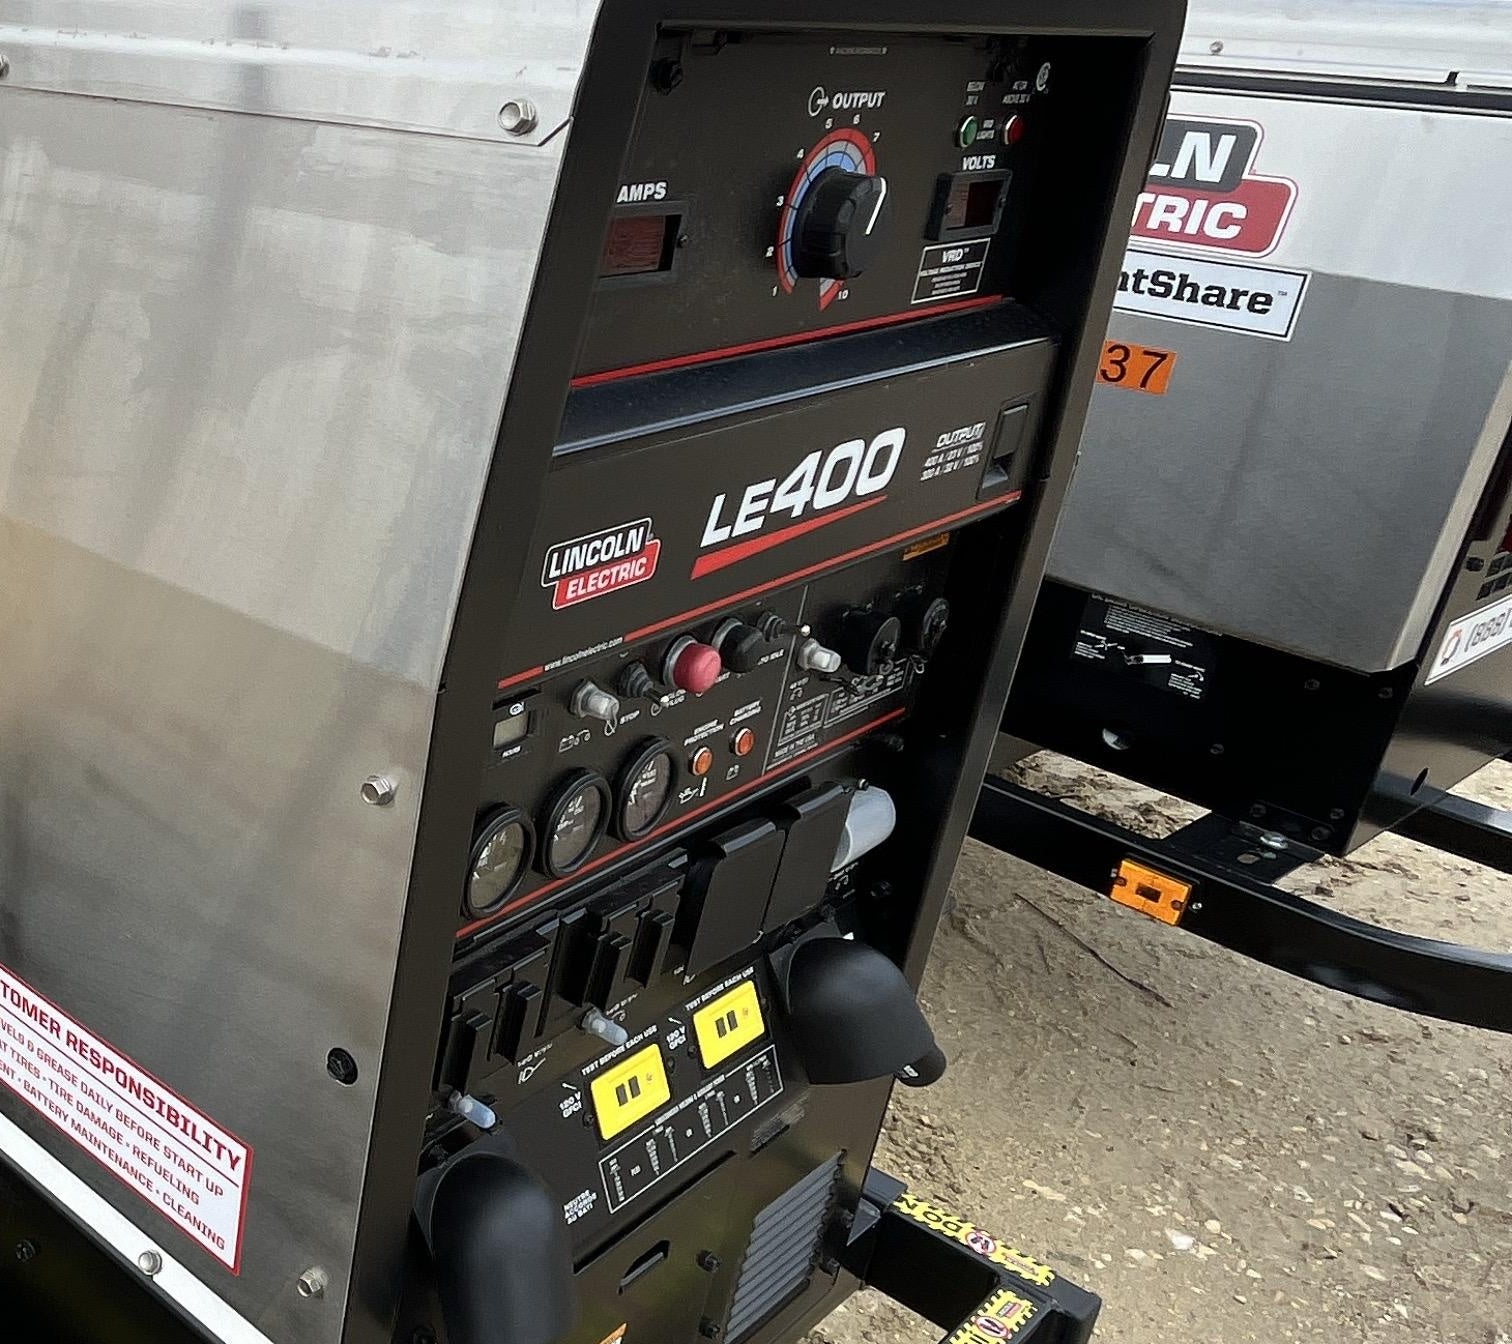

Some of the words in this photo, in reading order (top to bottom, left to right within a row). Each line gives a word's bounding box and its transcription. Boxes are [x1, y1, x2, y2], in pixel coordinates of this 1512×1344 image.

[832, 91, 886, 109] OUTPUT
[825, 118, 833, 129] 5
[853, 114, 861, 125] 6
[873, 132, 881, 142] 7
[797, 148, 805, 159] 4
[962, 154, 996, 171] VOLTS
[616, 181, 667, 204] AMPS
[776, 196, 785, 206] 3
[766, 246, 774, 258] 2
[772, 286, 778, 297] 1
[838, 289, 849, 301] 10
[936, 421, 986, 449] OUTPUT
[699, 427, 906, 548] LE400
[548, 526, 645, 579] LINCOLN
[565, 556, 648, 600] ELECTRIC
[619, 710, 640, 725] STOP
[685, 998, 702, 1012] TEST
[723, 975, 741, 990] EACH
[741, 965, 755, 981] USE
[666, 1029, 681, 1044] 120
[679, 1024, 686, 1036] V
[581, 1061, 600, 1077] TEST
[625, 1034, 644, 1052] EACH
[642, 1024, 658, 1041] USE
[66, 1029, 242, 1172] RESPONSIBILITY
[559, 1095, 576, 1111] 120
[573, 1090, 582, 1102] V
[10, 1048, 42, 1081] TIRES
[48, 1077, 74, 1106] TIRE
[76, 1097, 125, 1147] DAMAGE
[132, 1144, 201, 1206] REFUELING
[37, 1046, 78, 1086] GREASE
[81, 1081, 114, 1114] DAILY
[116, 1109, 161, 1152] BEFORE
[163, 1144, 204, 1183] START
[205, 1176, 225, 1198] UP
[23, 1079, 69, 1124] BATTERY
[71, 1117, 154, 1194] MAINTENANCE
[162, 1191, 227, 1251] CLEANING
[922, 1209, 963, 1233] DO
